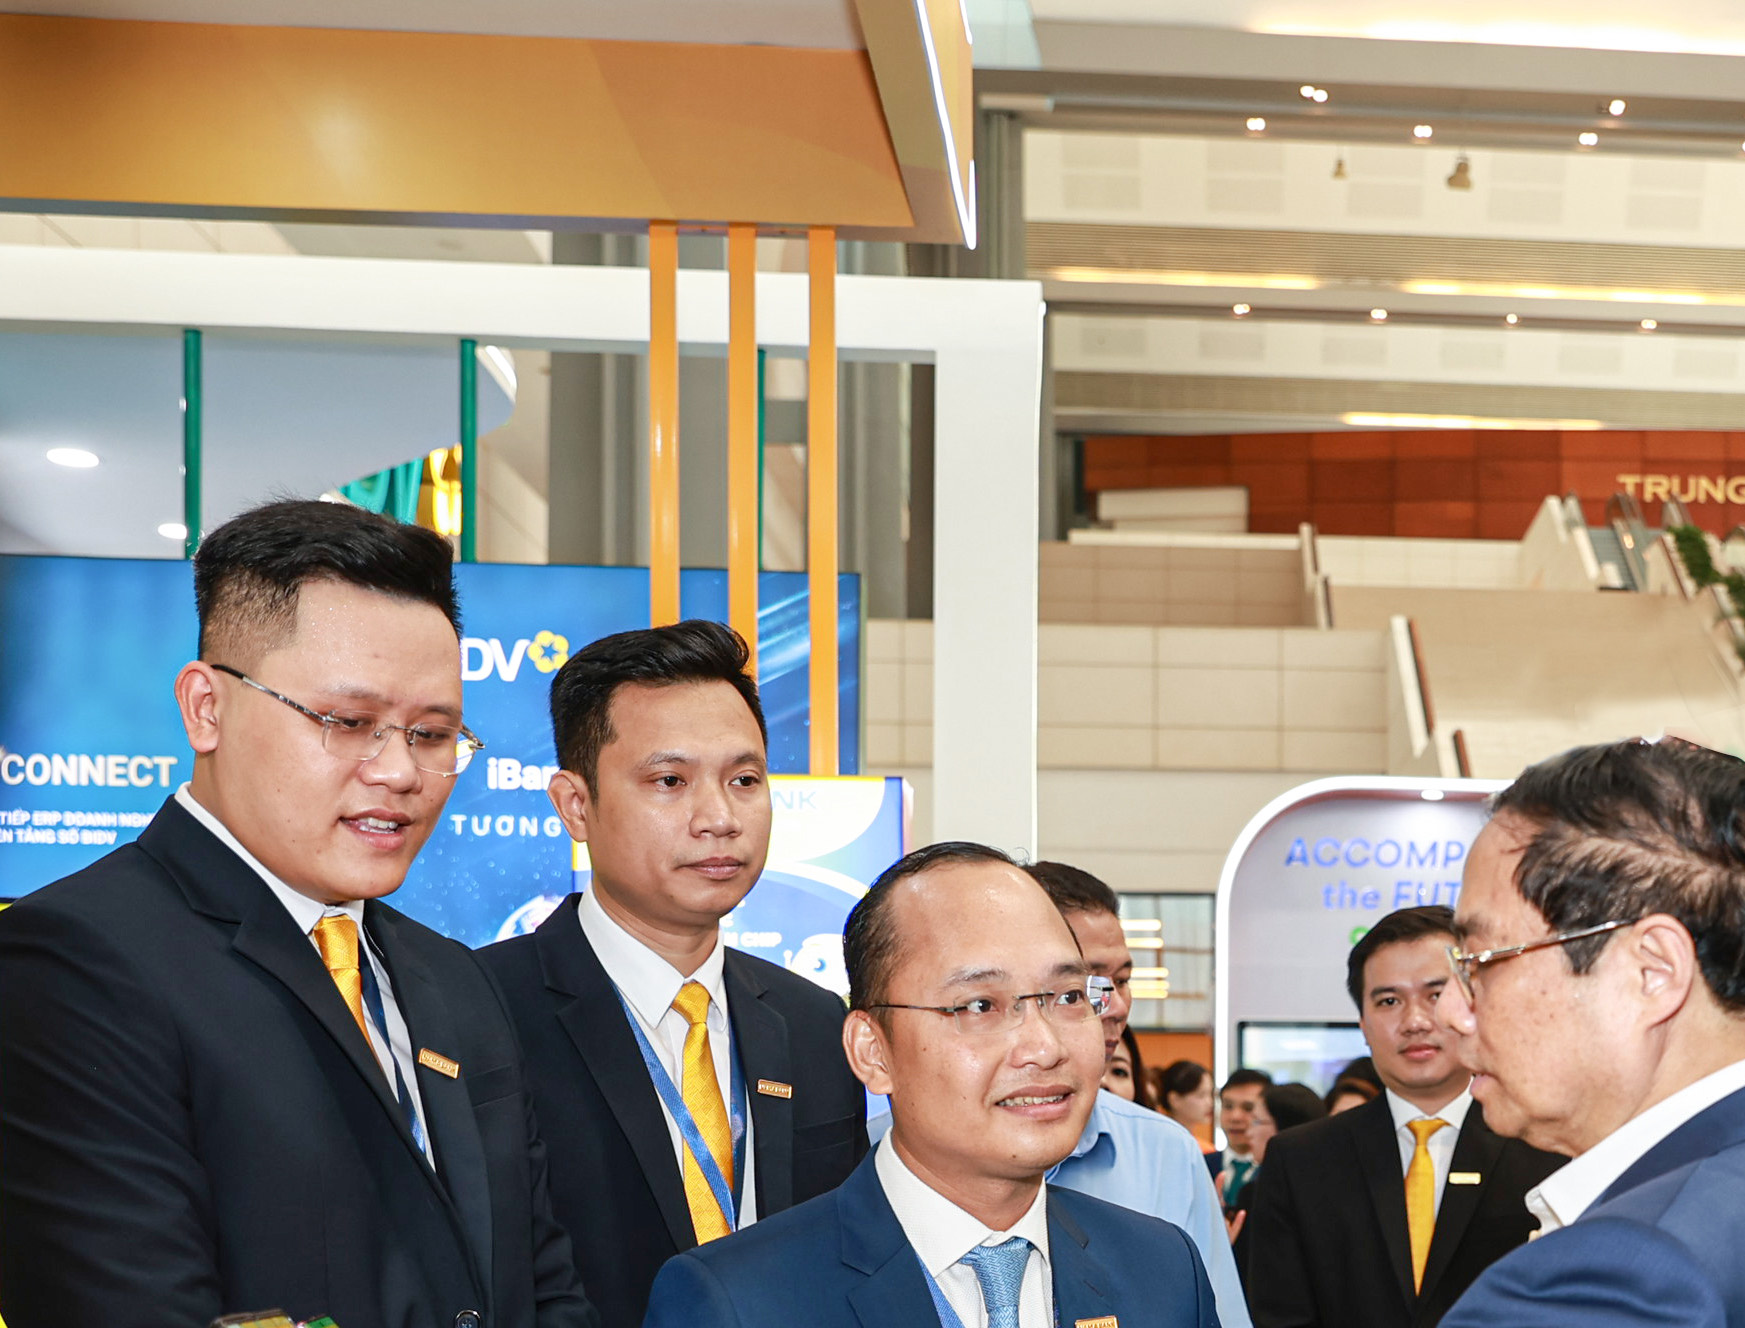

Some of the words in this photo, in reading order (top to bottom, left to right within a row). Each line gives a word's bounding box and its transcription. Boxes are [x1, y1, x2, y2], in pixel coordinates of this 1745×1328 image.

[461, 637, 531, 682] DV
[1285, 836, 1466, 868] ACCOMP
[1322, 880, 1382, 910] the
[1392, 880, 1462, 912] FUT
